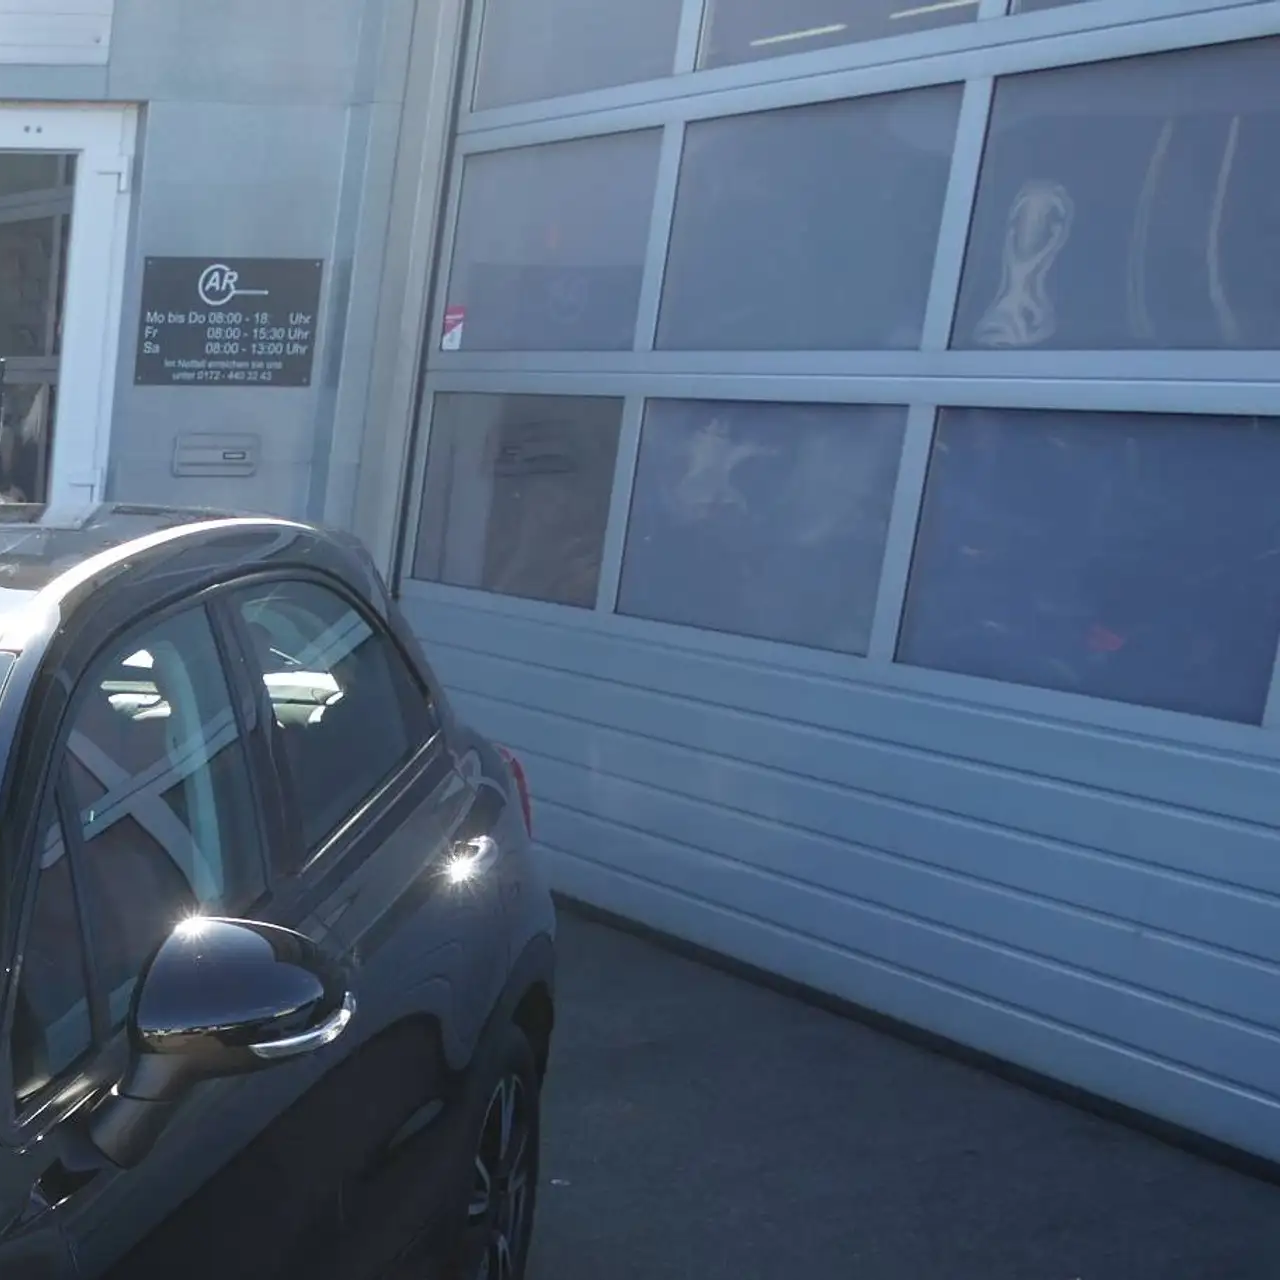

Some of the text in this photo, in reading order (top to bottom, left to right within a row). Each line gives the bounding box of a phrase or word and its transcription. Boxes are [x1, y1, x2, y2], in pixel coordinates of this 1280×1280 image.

[146, 311, 165, 324] Mo
[168, 311, 185, 324] bis
[188, 311, 206, 324] Do
[207, 311, 242, 325] 08:00
[289, 311, 311, 325] Uhr
[144, 326, 159, 338] Fr
[206, 326, 241, 339] 08:00
[253, 327, 285, 340] 15:30
[287, 327, 310, 340] Uhr
[143, 341, 160, 354] Sa
[205, 341, 239, 354] 08:00
[252, 342, 283, 355] 13:00
[286, 341, 308, 355] Uhr
